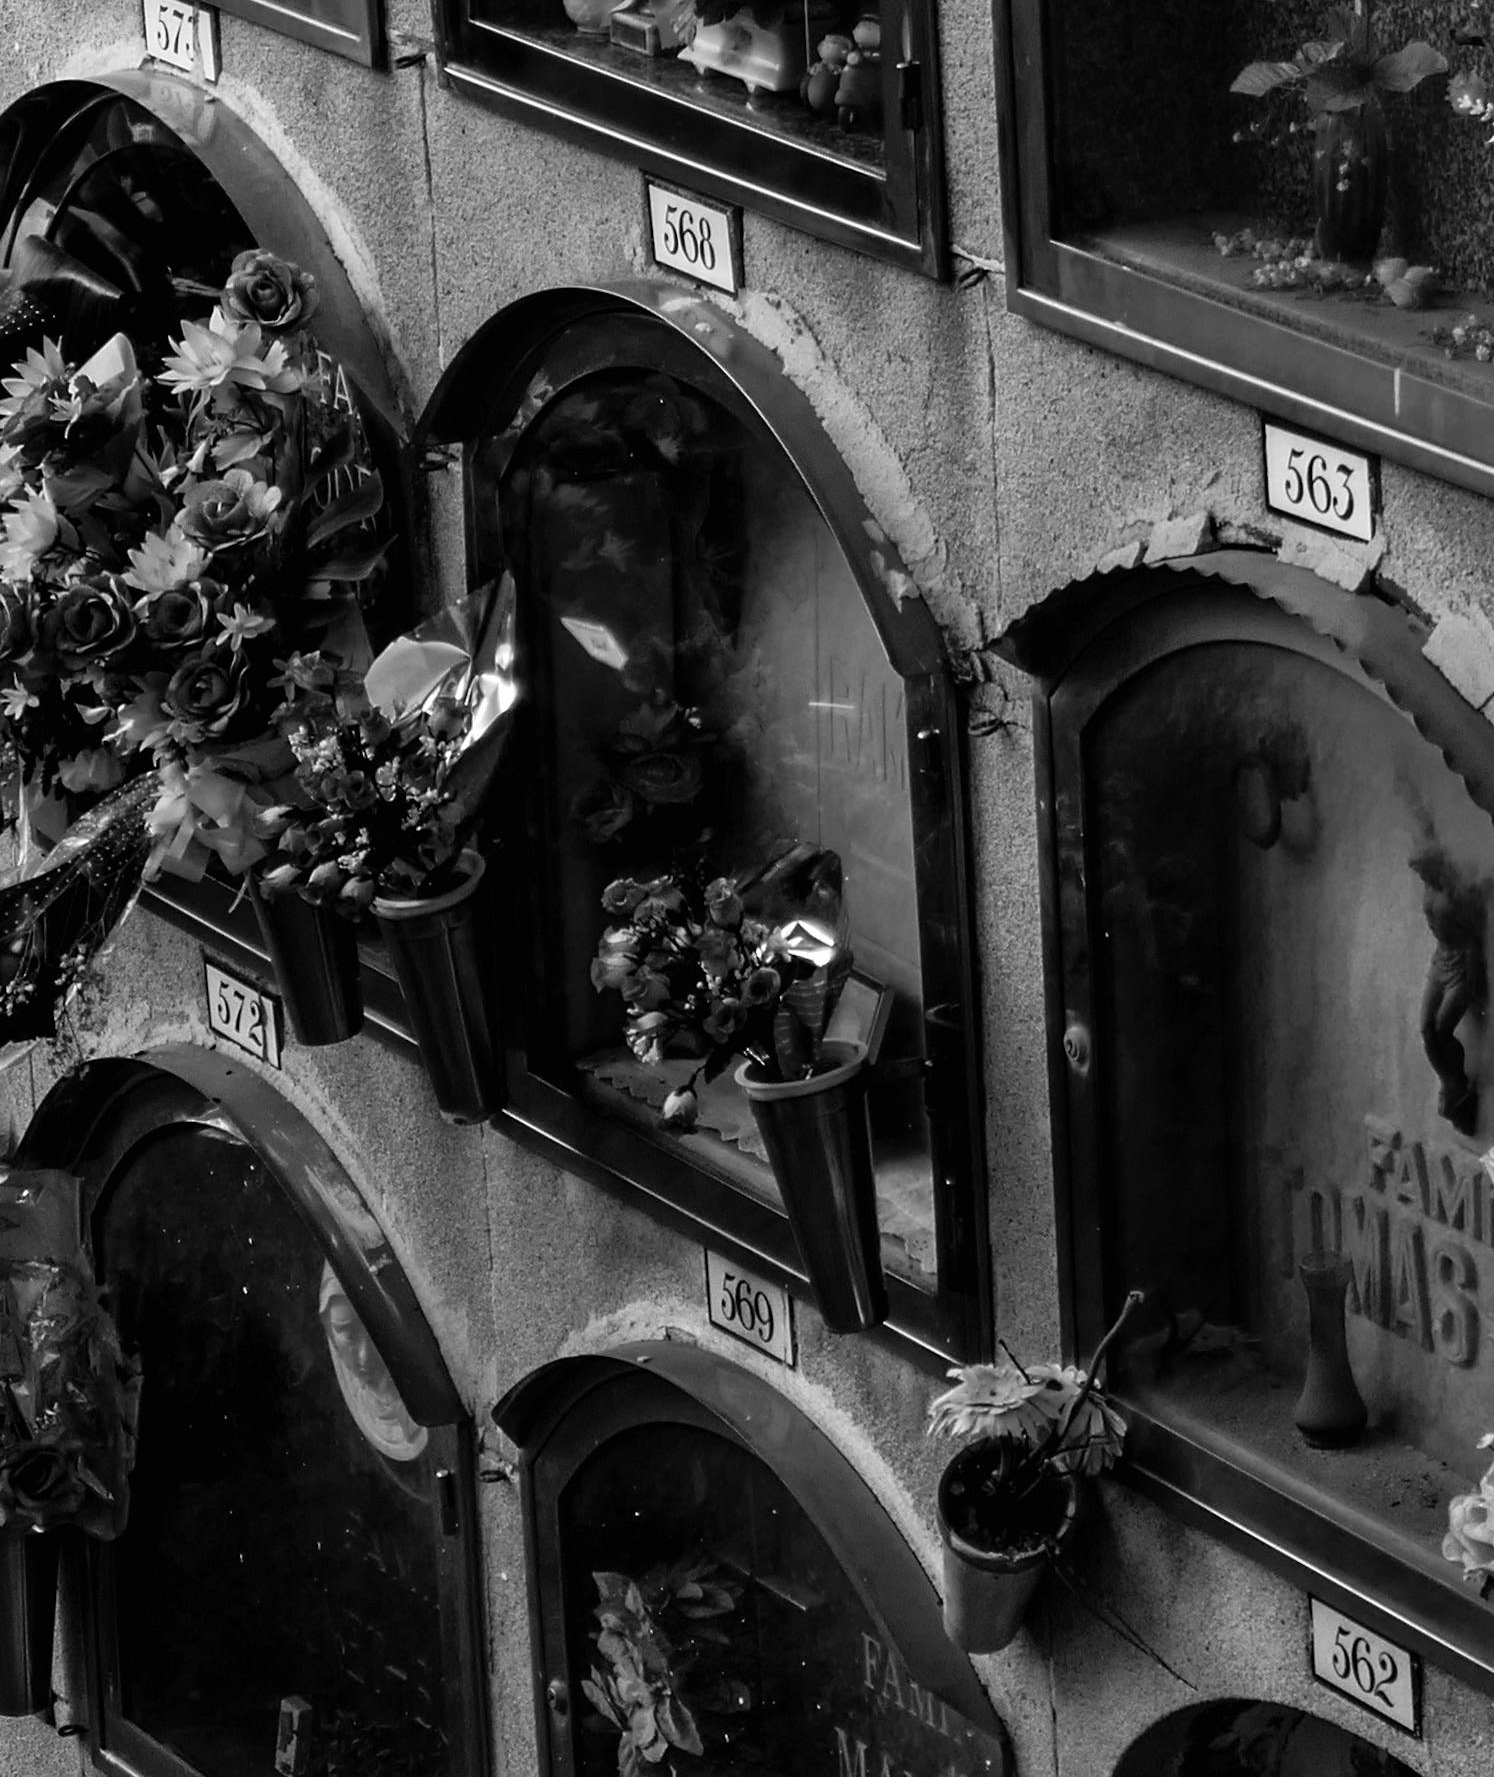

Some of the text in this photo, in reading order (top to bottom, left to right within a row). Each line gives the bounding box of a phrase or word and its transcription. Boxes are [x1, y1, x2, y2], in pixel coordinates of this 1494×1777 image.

[663, 205, 715, 270] 568
[1284, 448, 1356, 520] 563
[216, 982, 263, 1043] 572
[720, 1272, 774, 1342] 569
[1332, 1625, 1398, 1707] 562
